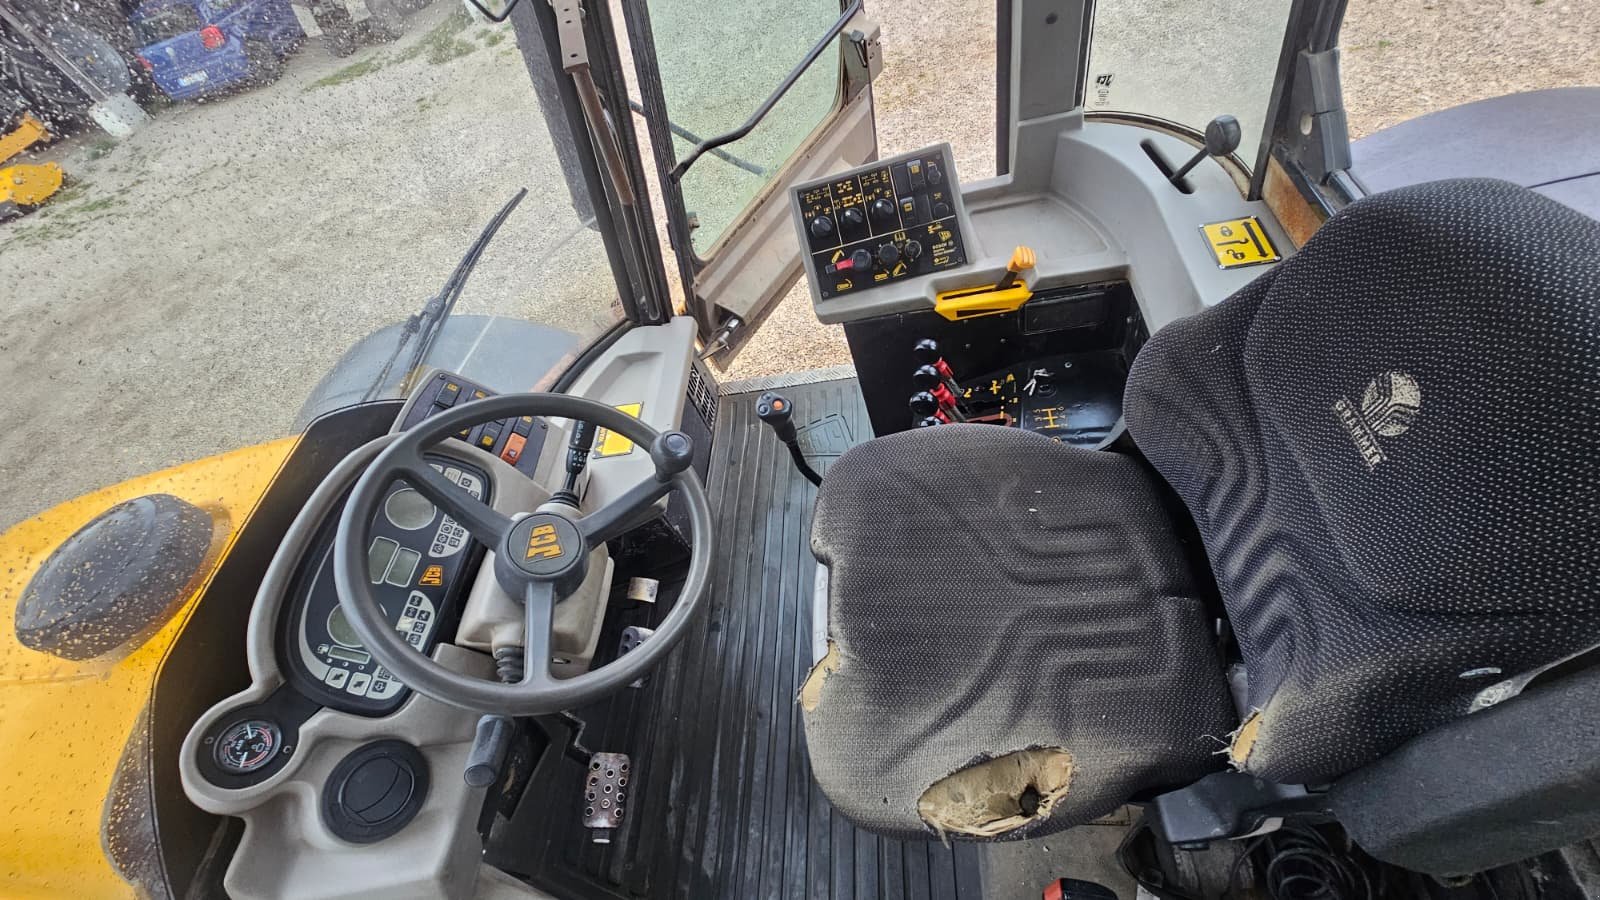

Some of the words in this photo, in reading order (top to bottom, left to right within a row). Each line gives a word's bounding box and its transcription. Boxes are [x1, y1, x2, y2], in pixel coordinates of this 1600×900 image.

[1334, 399, 1381, 465] GRAMMER
[527, 525, 562, 558] JCB
[422, 567, 441, 585] JCB
